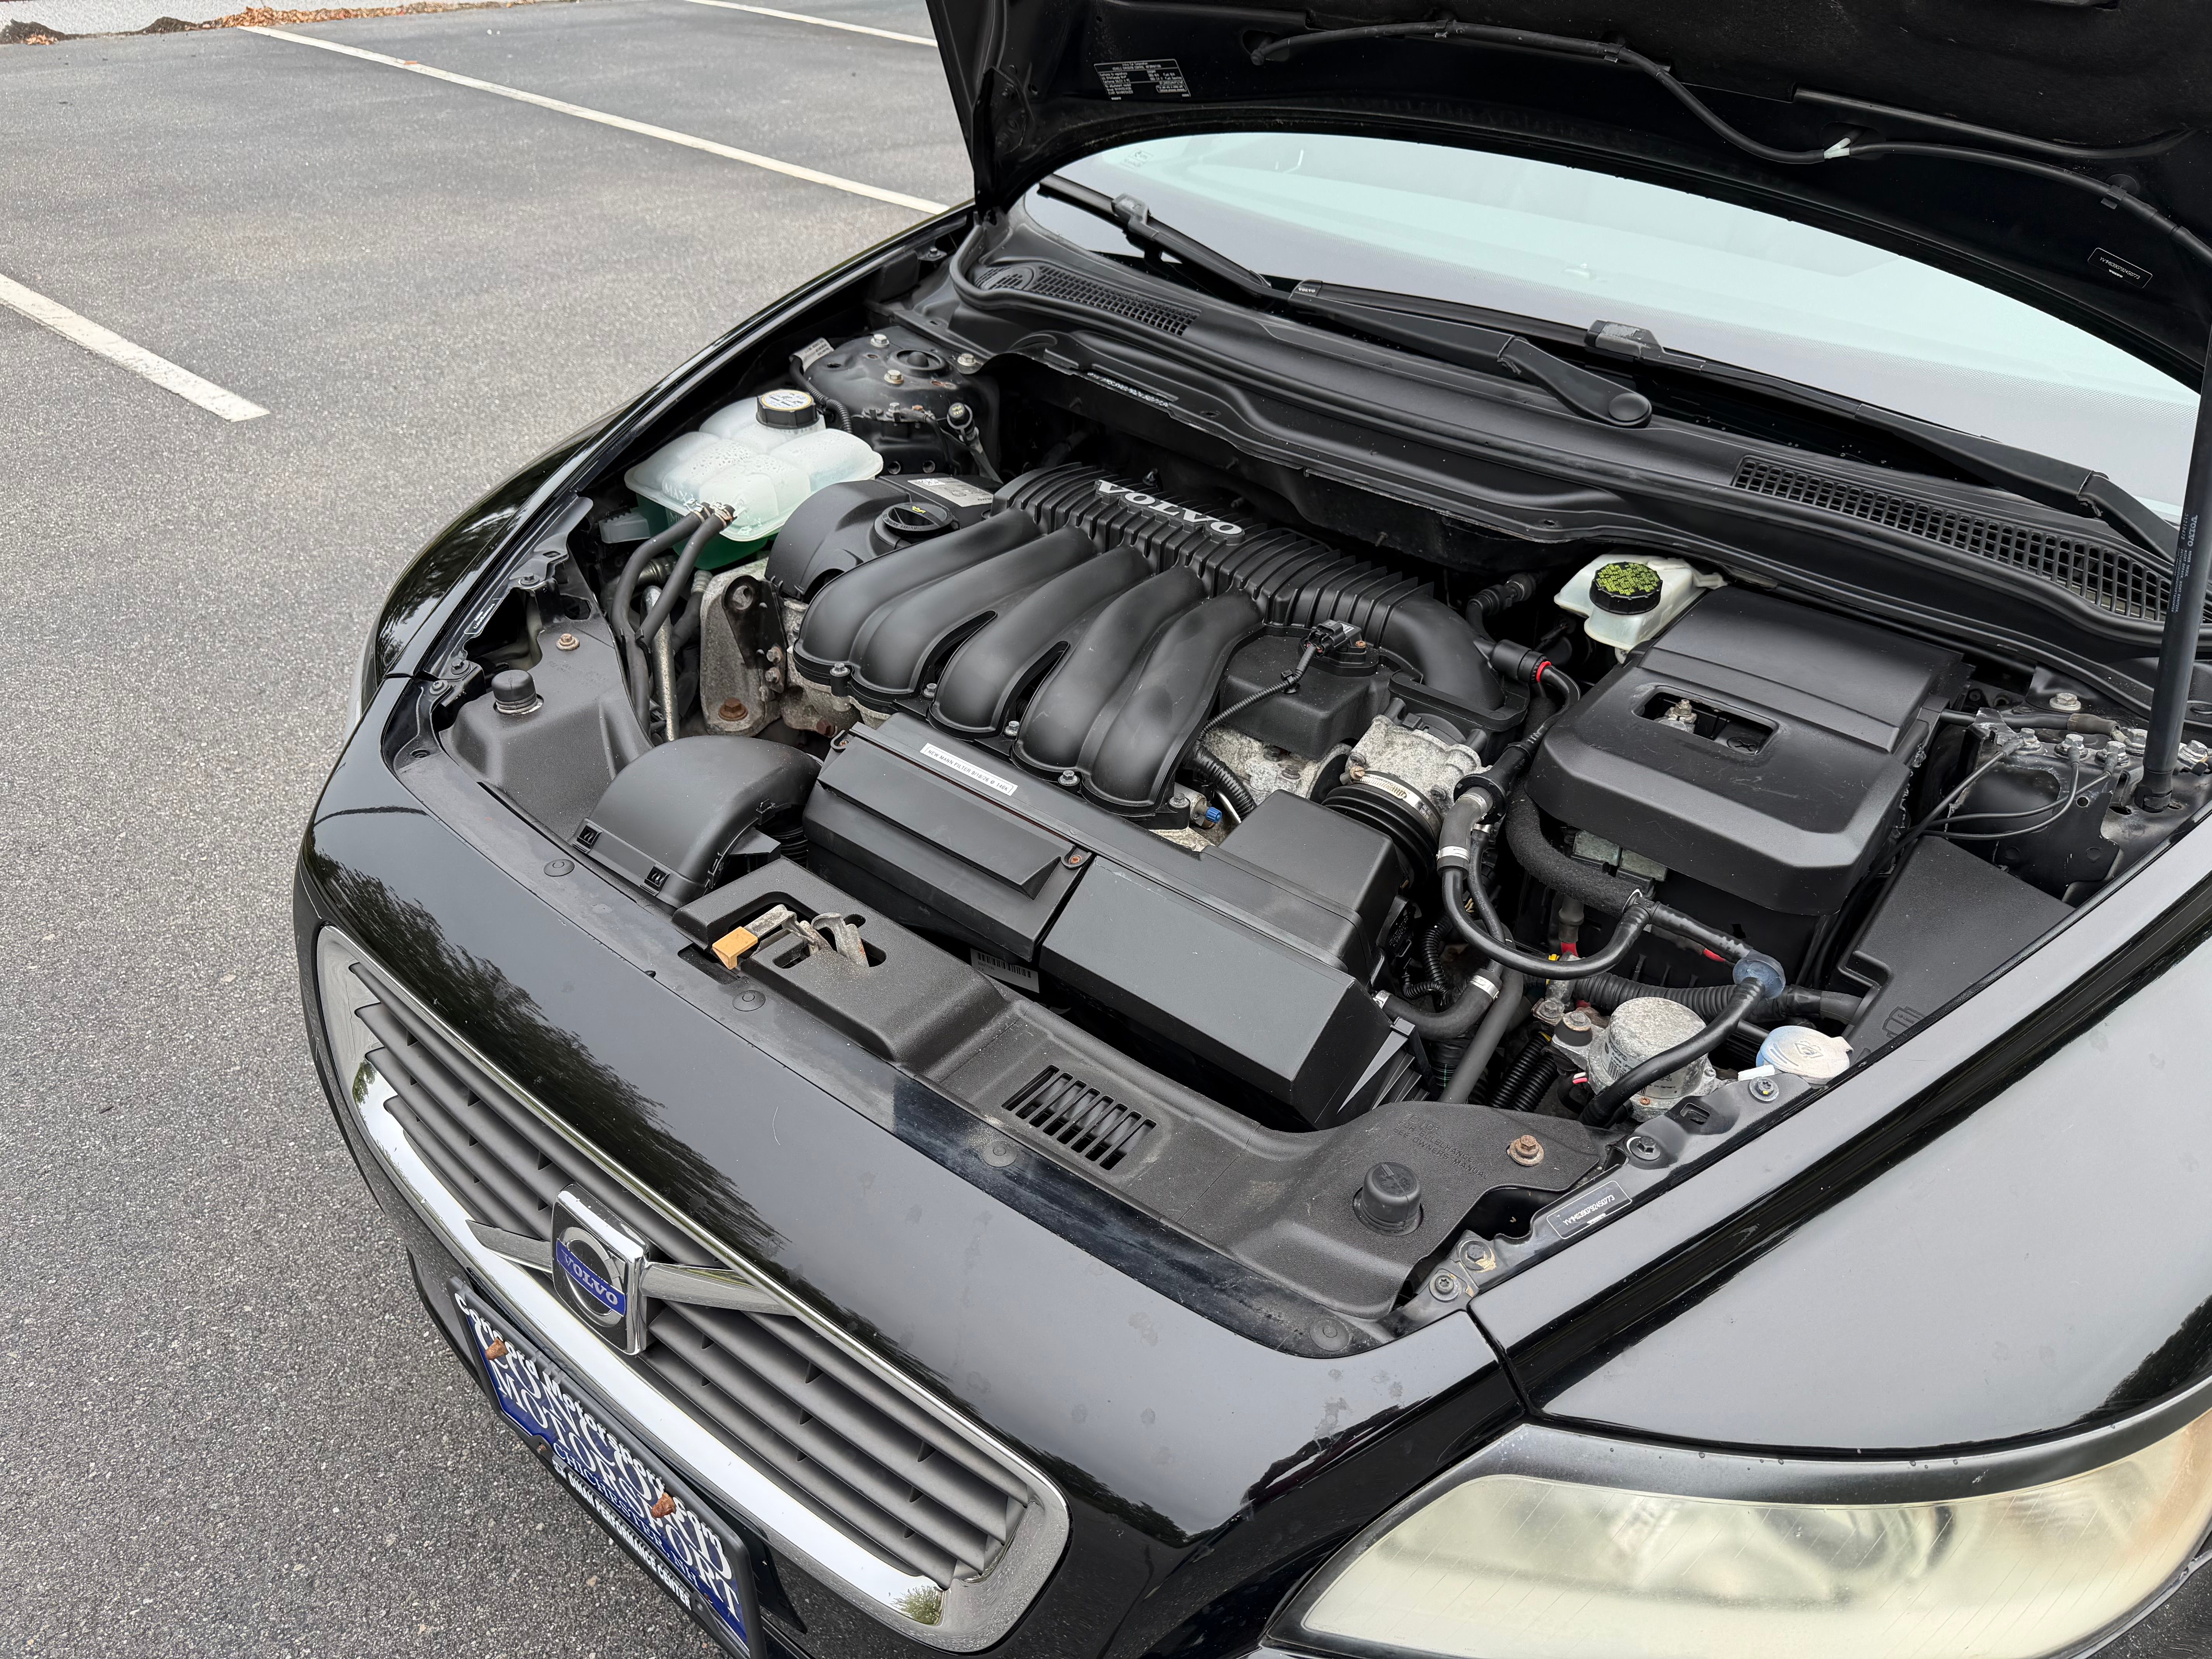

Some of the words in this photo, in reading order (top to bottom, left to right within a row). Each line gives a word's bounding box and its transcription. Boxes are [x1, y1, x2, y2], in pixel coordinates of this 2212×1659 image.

[665, 482, 687, 503] MAX
[1098, 479, 1242, 534] VOLVO
[2188, 515, 2198, 547] VOLVO
[939, 755, 953, 765] MANN
[954, 762, 970, 773] FILTER
[1413, 1136, 1450, 1160] OWNERS
[1452, 1158, 1487, 1180] MANUAL
[1563, 1194, 1615, 1226] YV1MS390792450773
[561, 1249, 618, 1305] VOLVO
[489, 1360, 740, 1623] MOTORSPORT
[553, 1443, 671, 1558] CHICHESTER,
[670, 1551, 700, 1589] NH
[568, 1474, 596, 1508] DINAN
[595, 1499, 658, 1572] PERFORMANCE
[657, 1565, 692, 1611] CENTER
